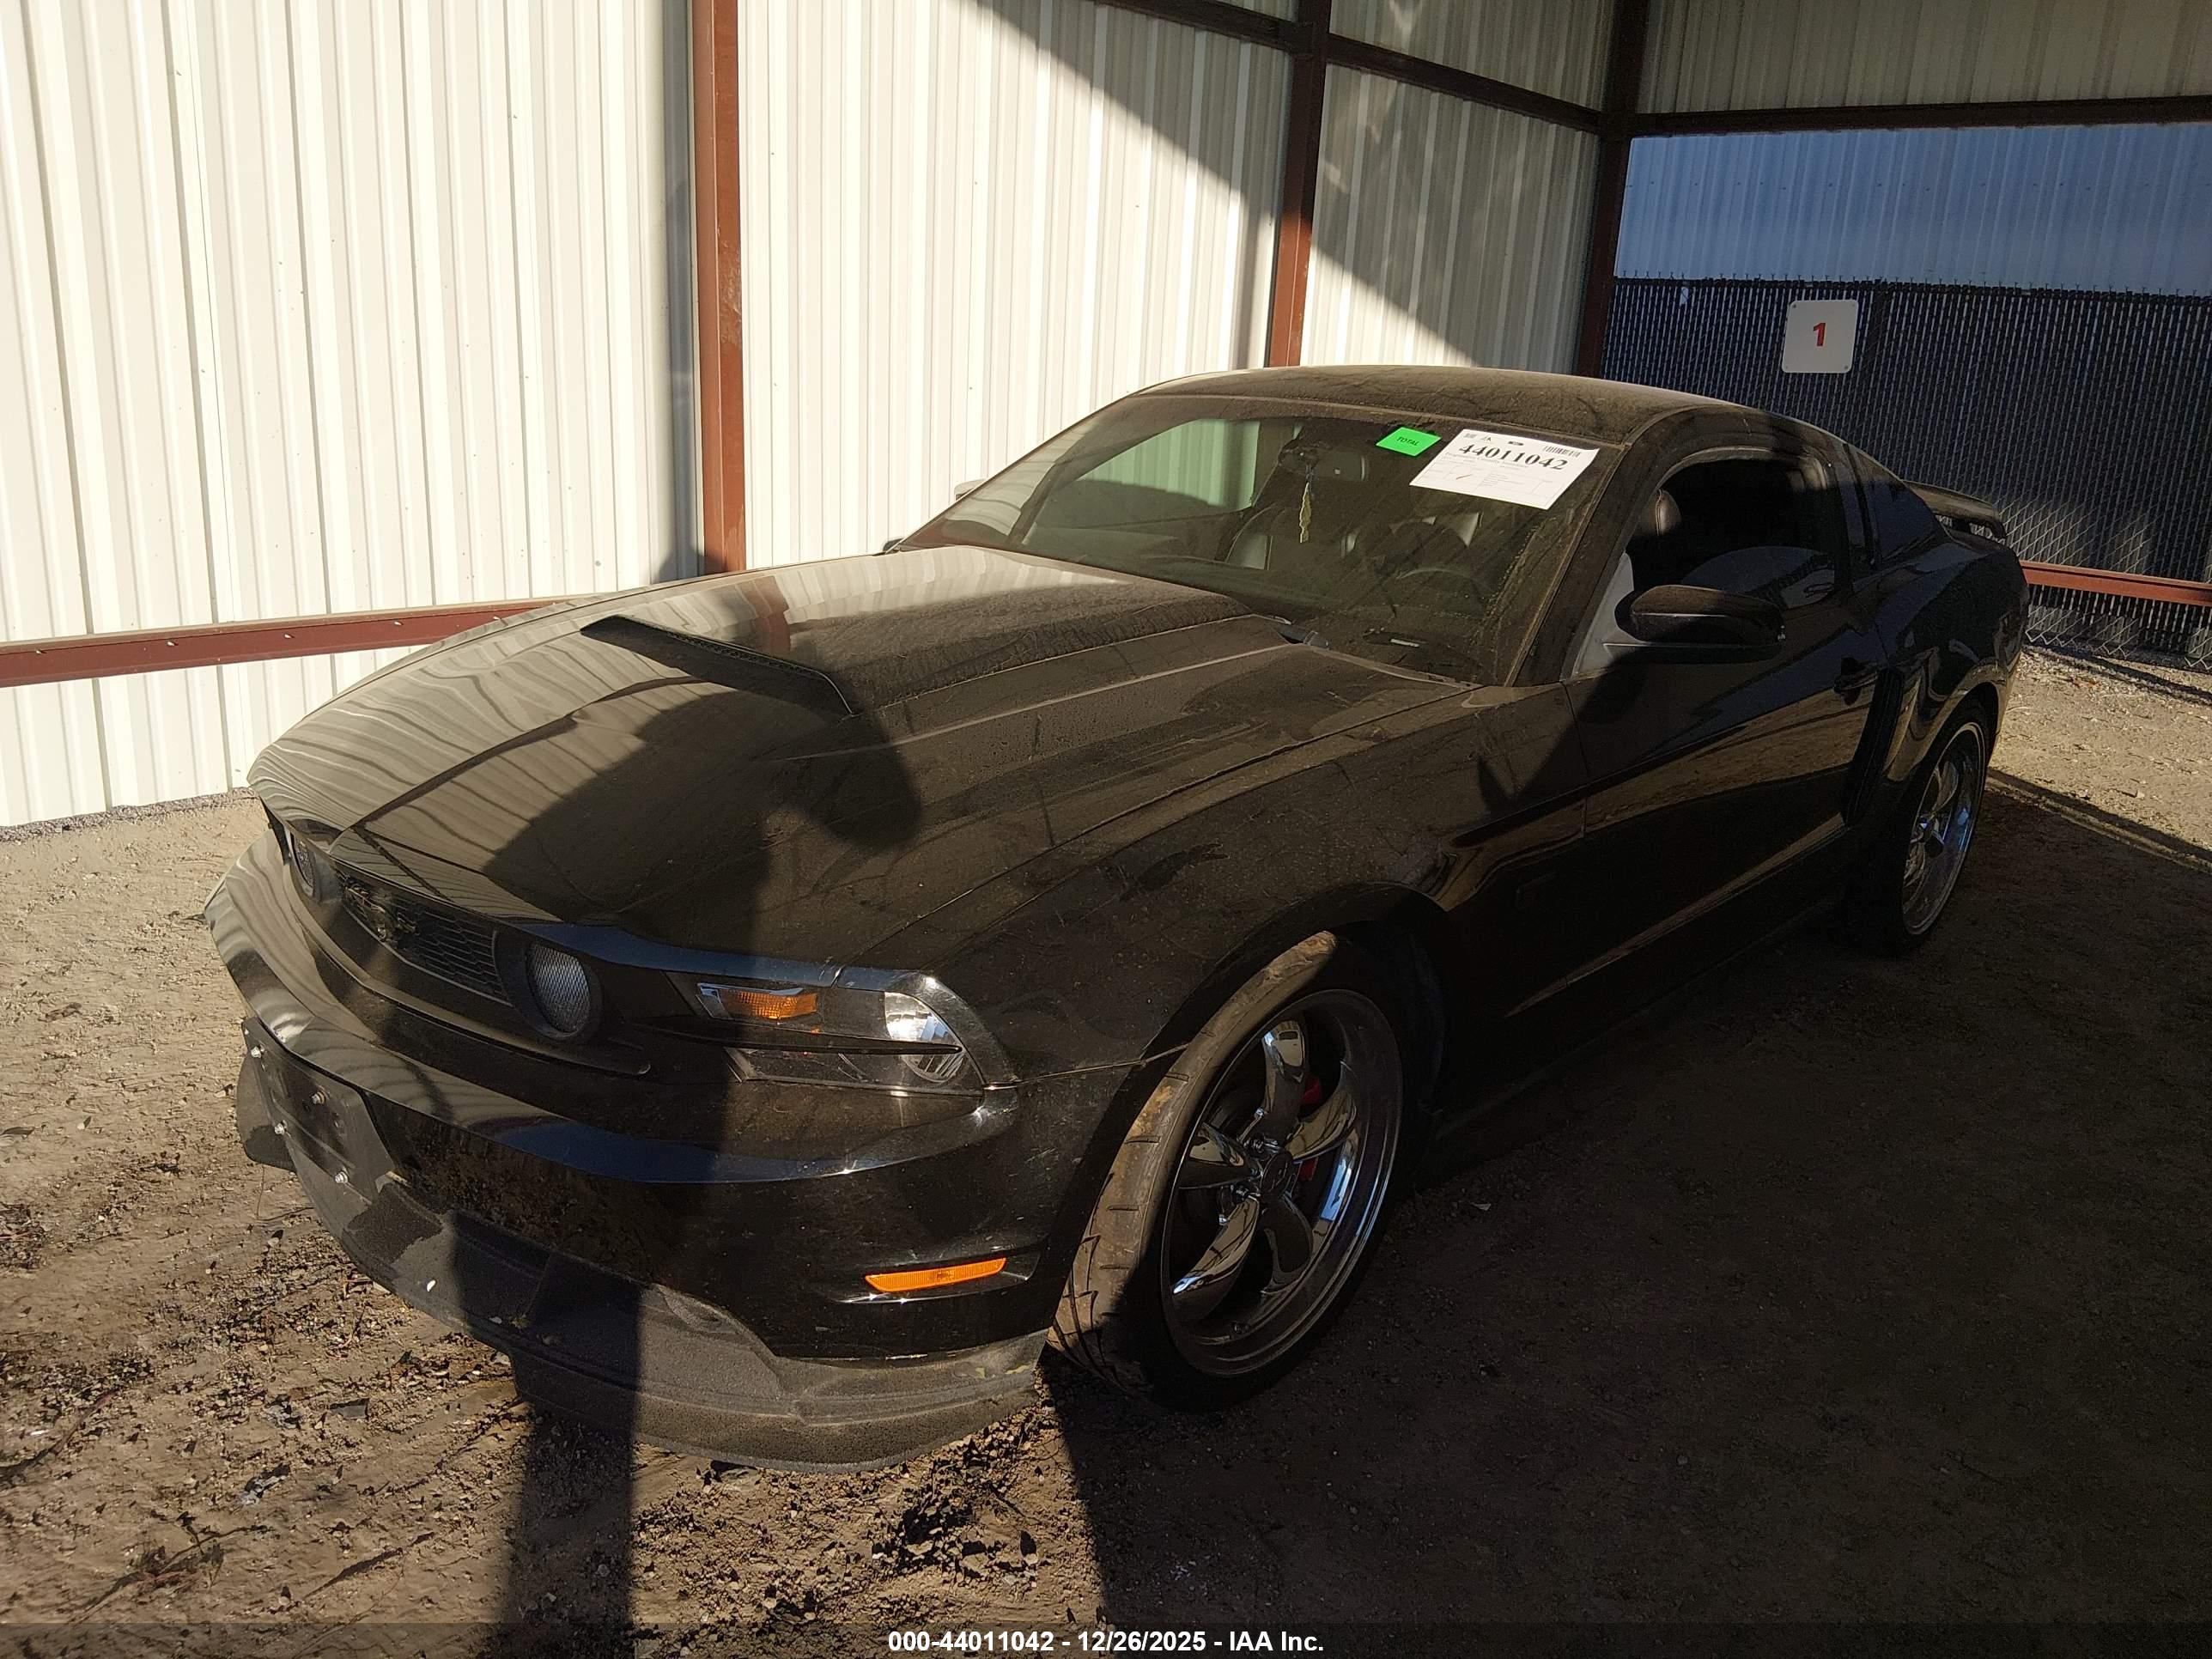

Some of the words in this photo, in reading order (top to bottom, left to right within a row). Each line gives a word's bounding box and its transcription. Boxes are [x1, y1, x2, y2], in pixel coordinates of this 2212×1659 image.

[1813, 322, 1826, 347] 1
[1396, 435, 1420, 447] TOTAL
[1459, 443, 1569, 471] 44011042
